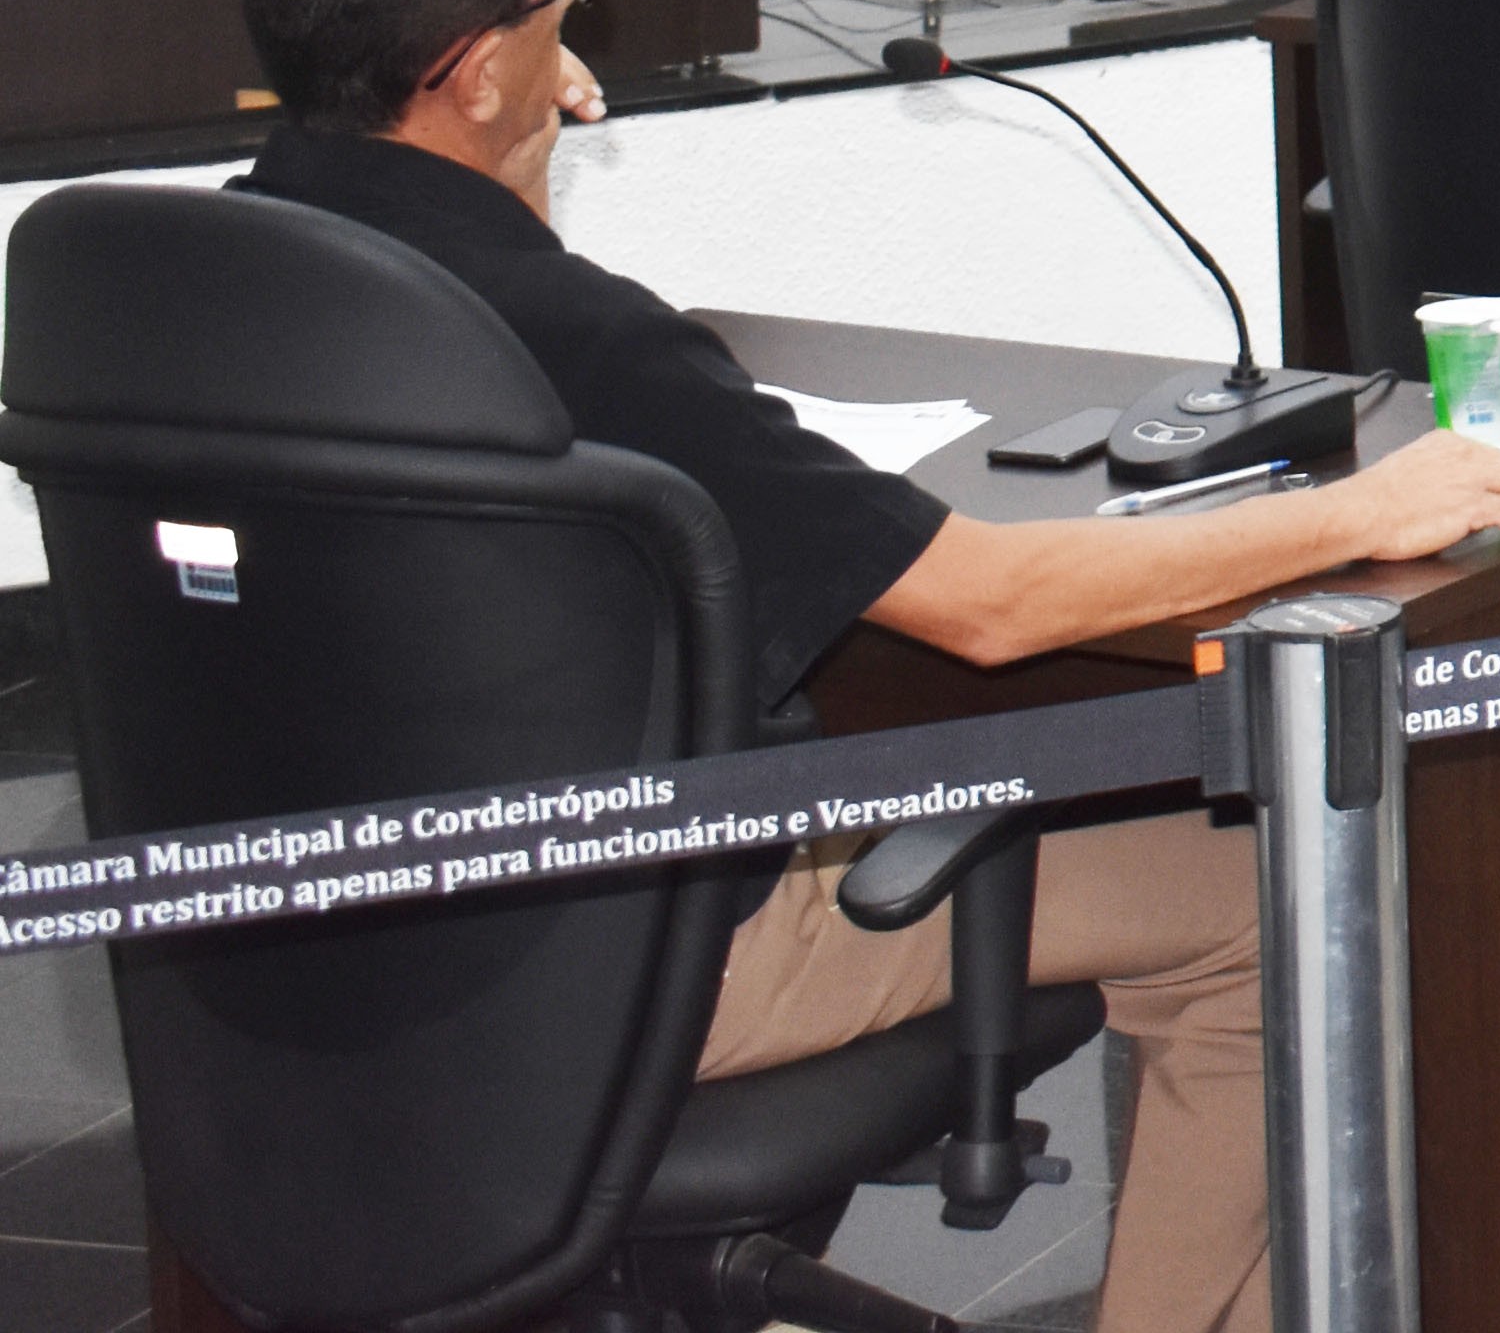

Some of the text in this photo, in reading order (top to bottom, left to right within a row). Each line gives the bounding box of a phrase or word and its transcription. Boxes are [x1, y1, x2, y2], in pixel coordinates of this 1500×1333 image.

[1415, 656, 1455, 686] de
[1404, 702, 1479, 735] enas
[0, 776, 676, 895] âmara Municipal de Cordeirópolis
[131, 883, 286, 928] restrito
[293, 863, 434, 910] apenas
[443, 848, 532, 894] para
[538, 813, 780, 871] funcionários
[788, 810, 810, 834] e
[816, 777, 1035, 830] Vereadores.
